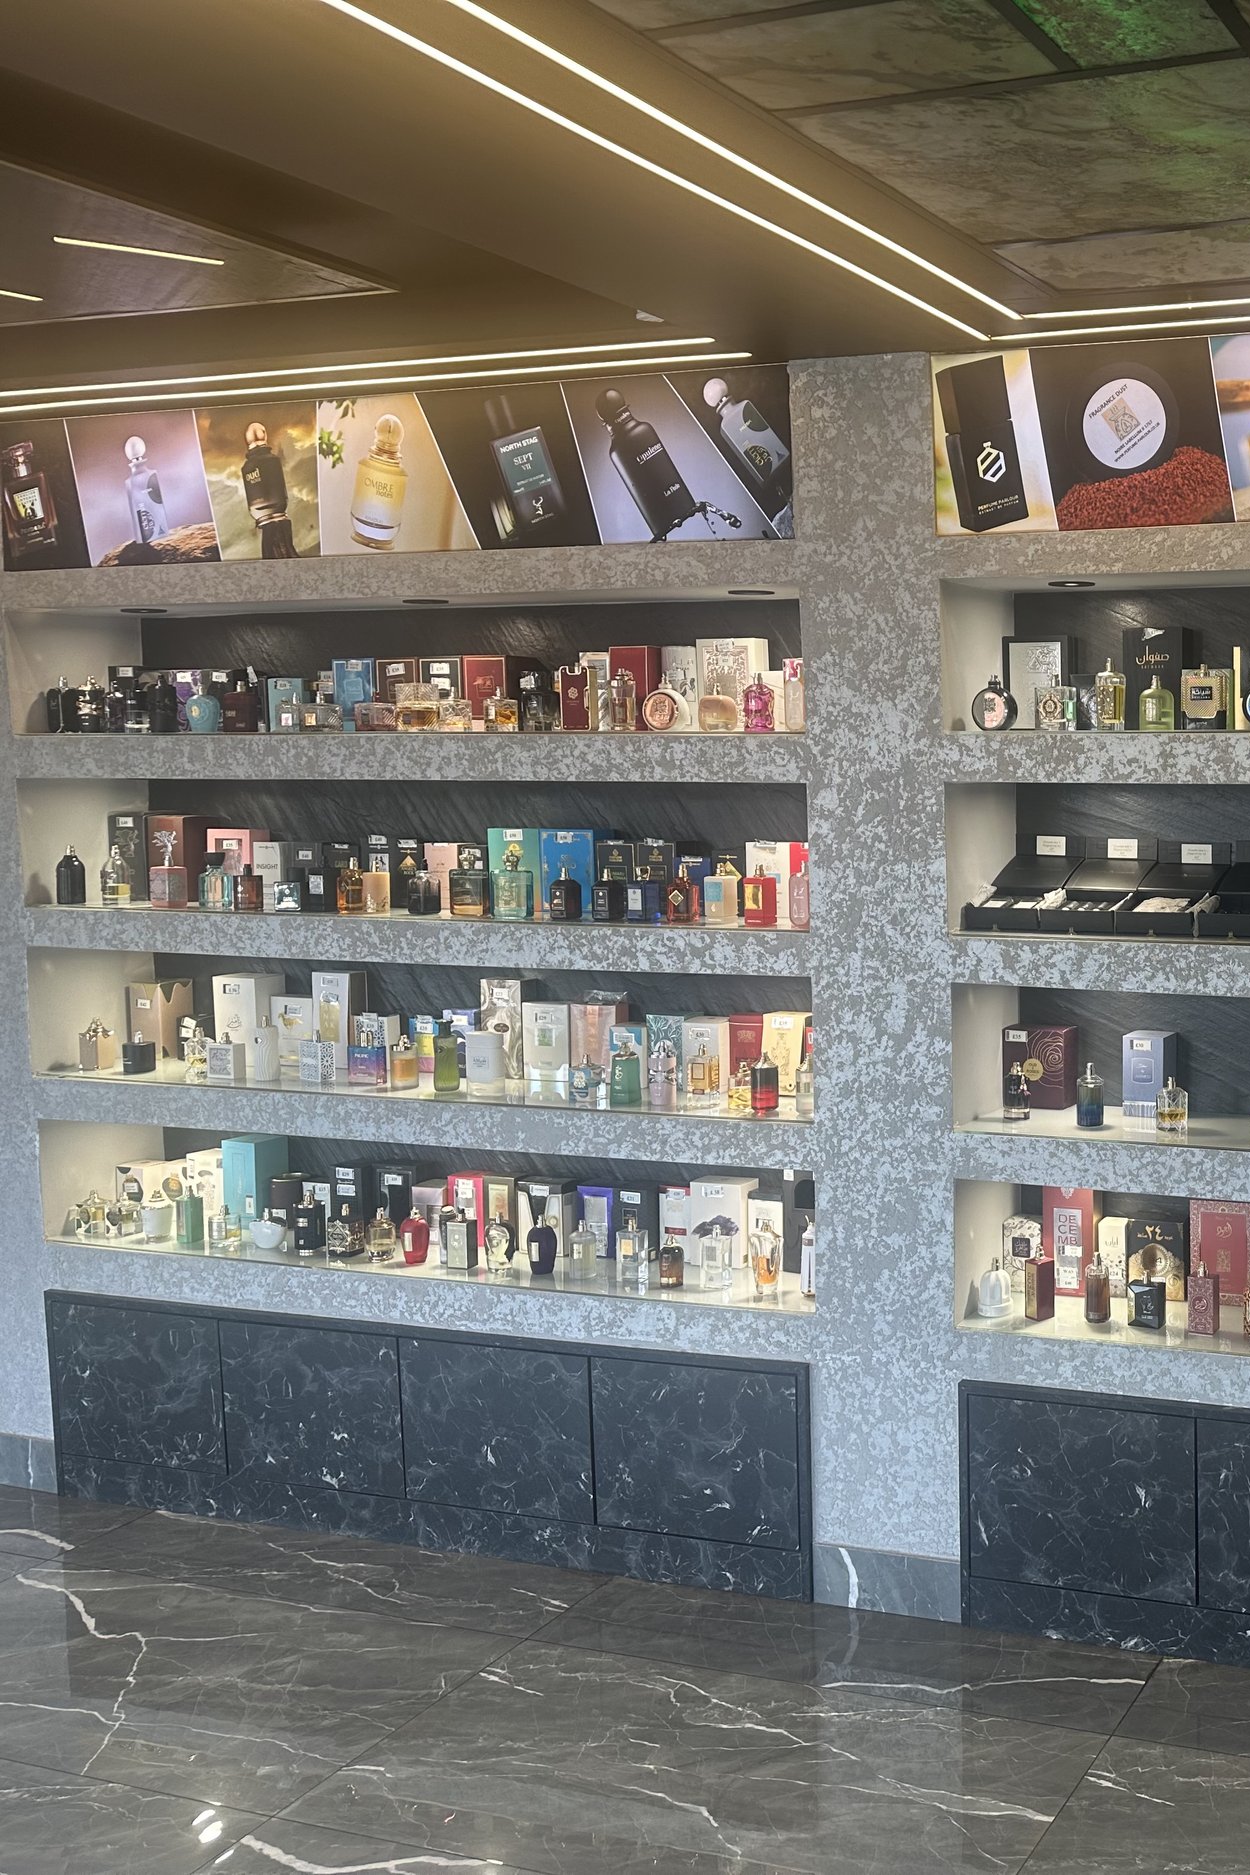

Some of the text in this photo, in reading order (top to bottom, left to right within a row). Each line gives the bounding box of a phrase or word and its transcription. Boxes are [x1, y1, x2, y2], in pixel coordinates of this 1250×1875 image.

[1088, 383, 1128, 419] FRAGRANCE DUST
[500, 436, 538, 454] NORTH STAG
[513, 452, 533, 466] SEPT
[364, 477, 394, 493] OMBRE
